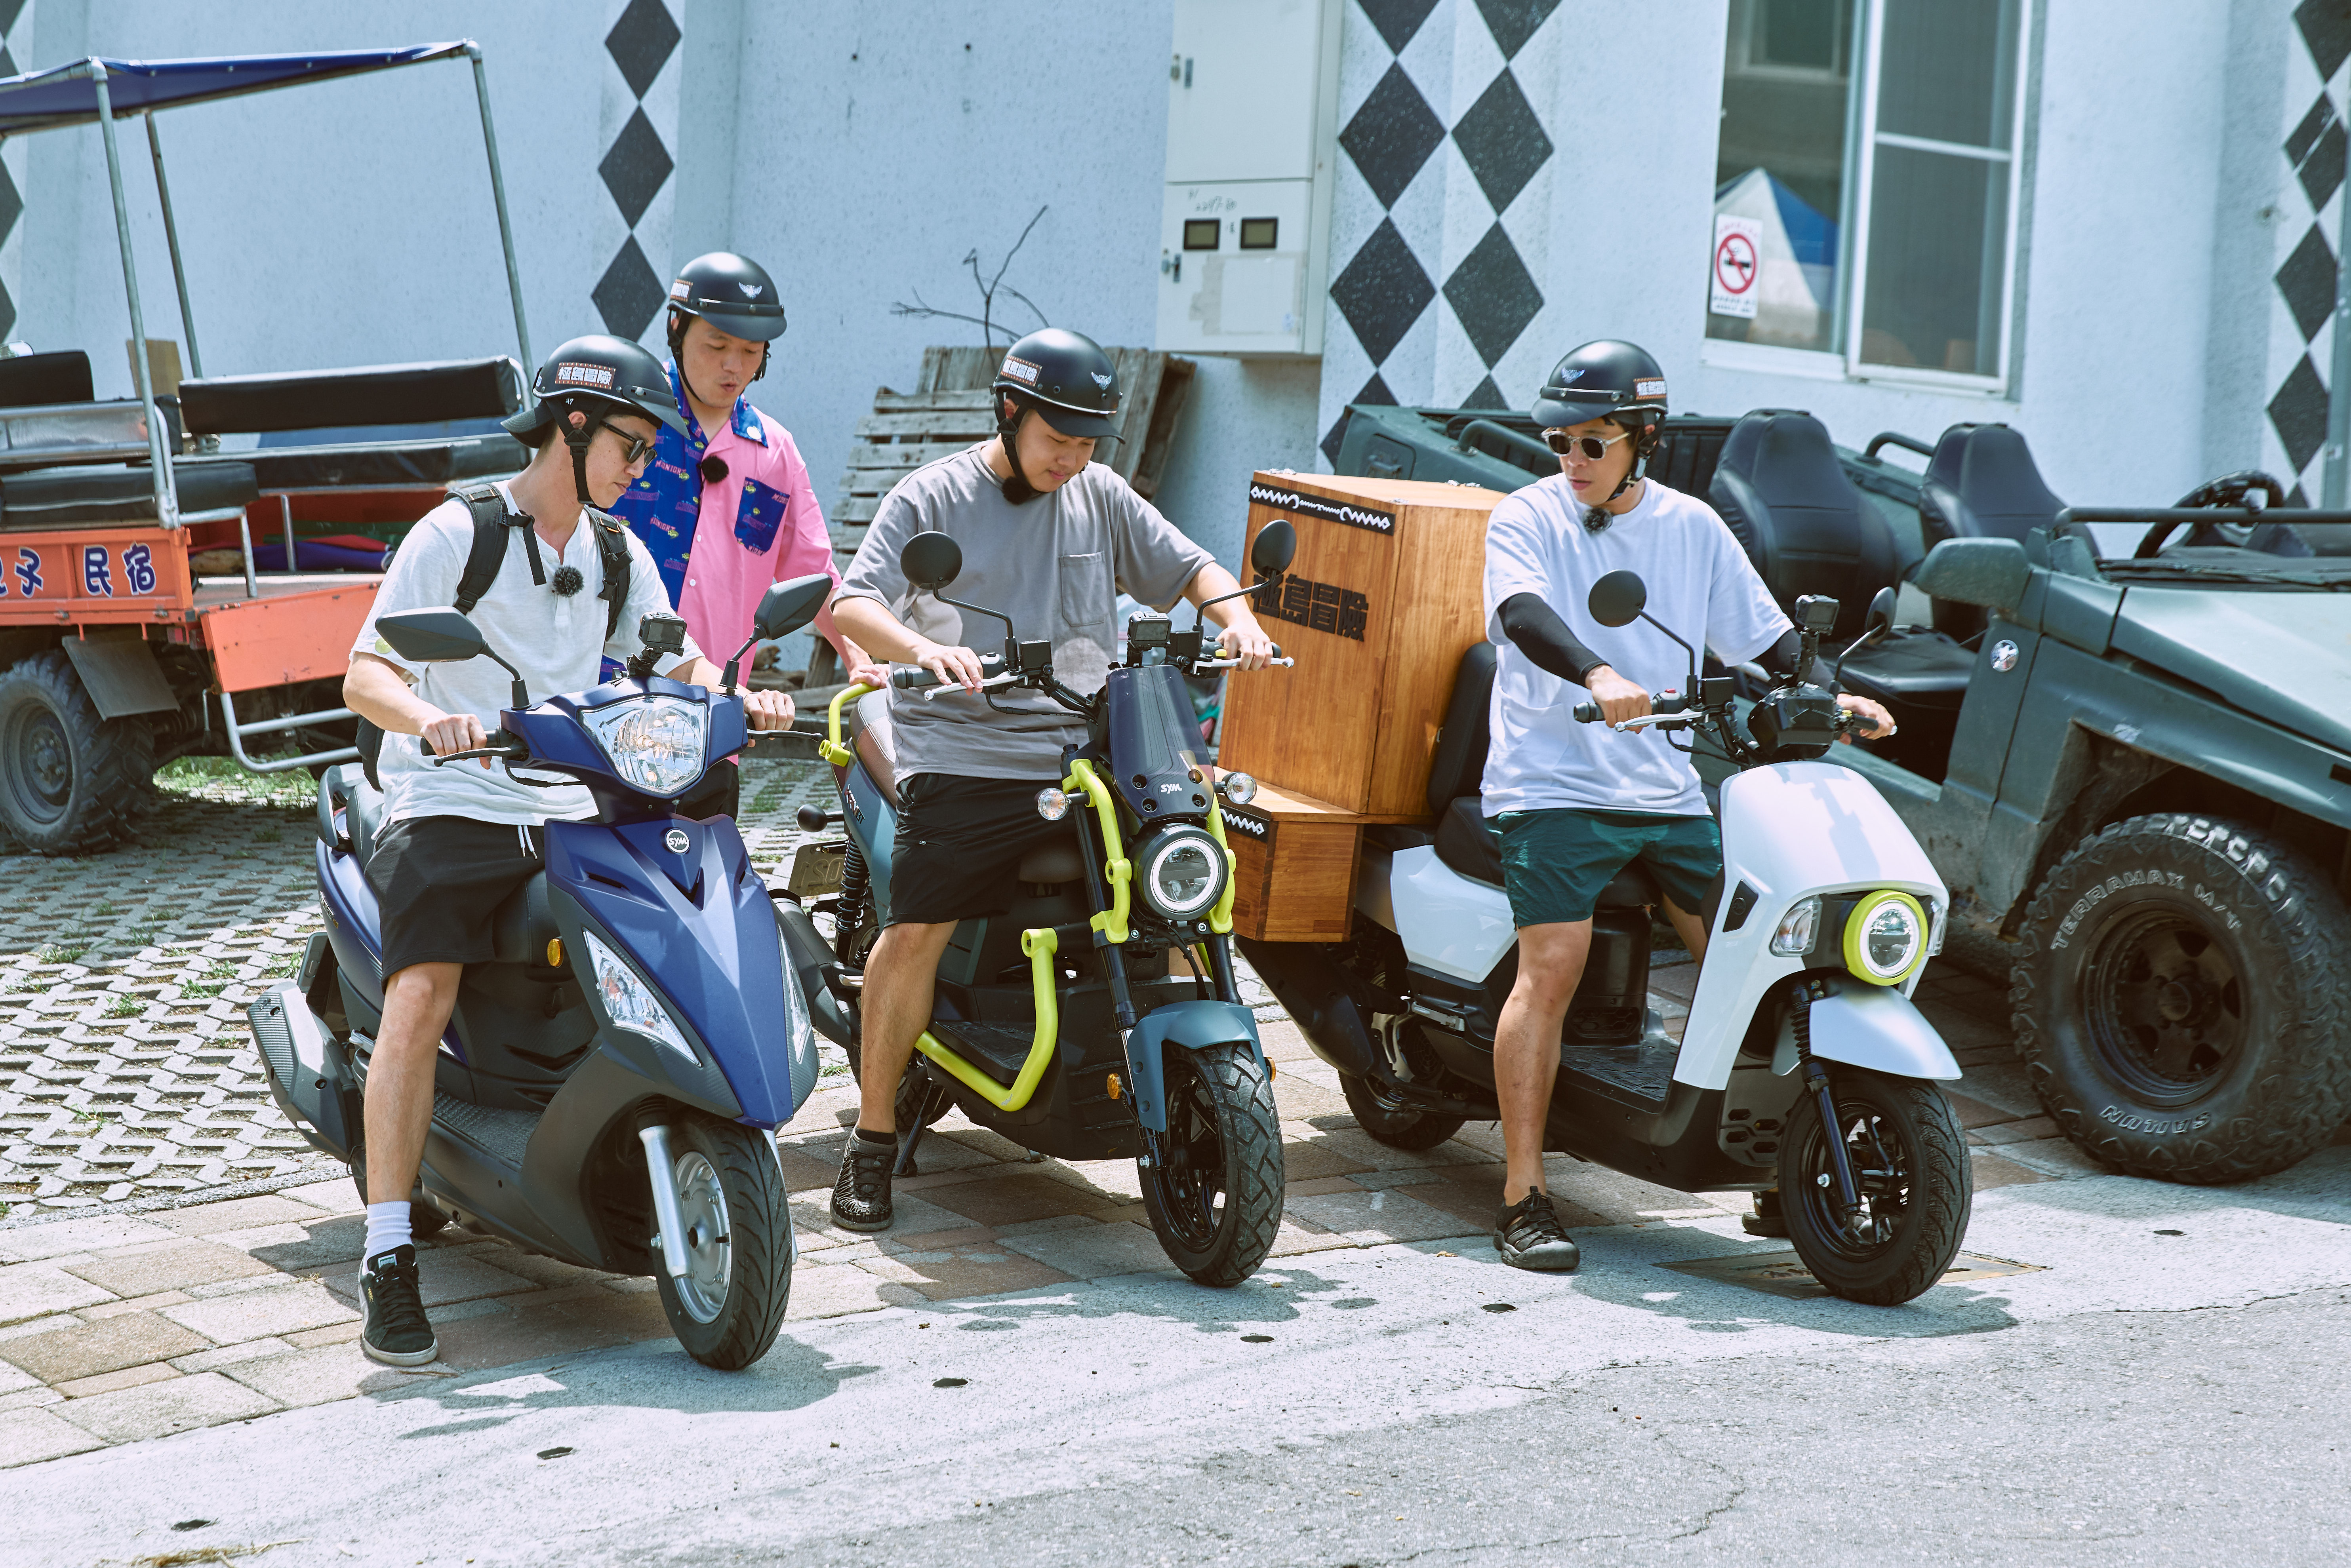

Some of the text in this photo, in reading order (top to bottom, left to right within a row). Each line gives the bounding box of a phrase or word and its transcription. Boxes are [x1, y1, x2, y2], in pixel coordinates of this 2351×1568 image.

[558, 367, 612, 385] 極島冒險
[83, 540, 156, 598] 民宿
[1161, 783, 1183, 794] SYM
[669, 837, 687, 847] SYM
[2050, 870, 2186, 950] TERRAMAX
[2099, 1105, 2211, 1134] SAILUN
